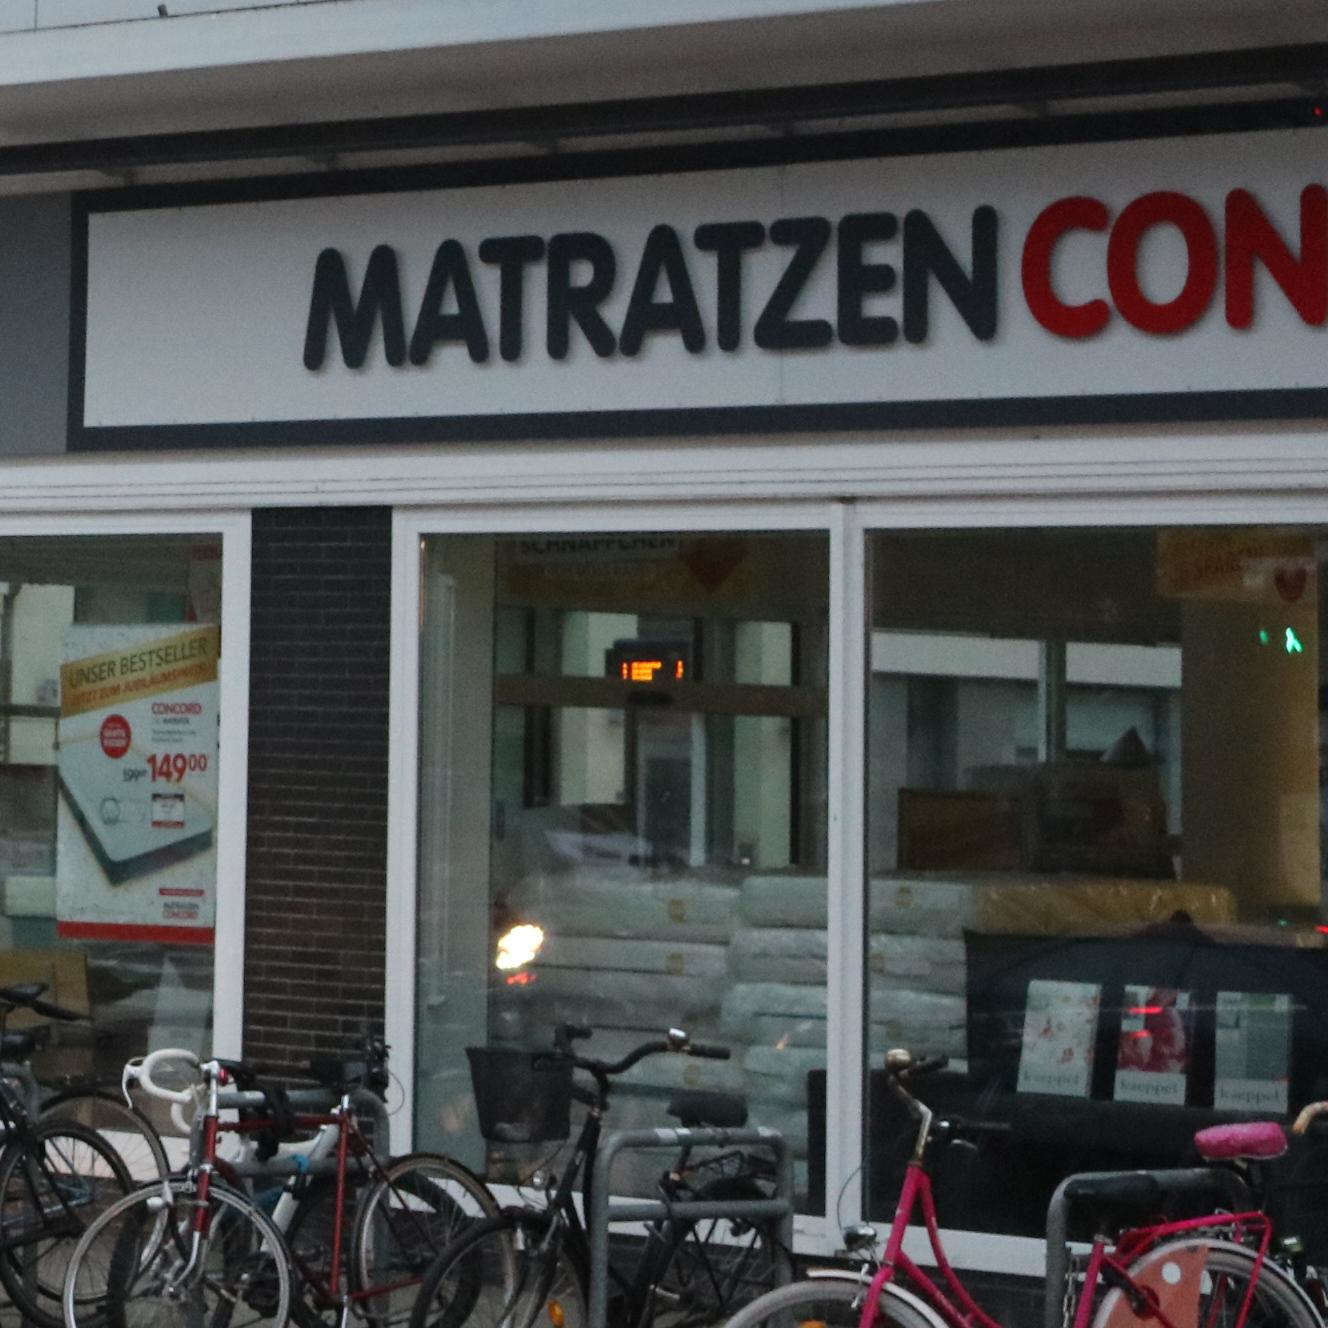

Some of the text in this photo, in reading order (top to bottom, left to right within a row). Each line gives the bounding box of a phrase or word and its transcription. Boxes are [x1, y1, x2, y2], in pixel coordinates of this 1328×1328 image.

[302, 204, 1000, 372] MATRATZEN
[68, 637, 209, 689] UNSER BESTSELLER
